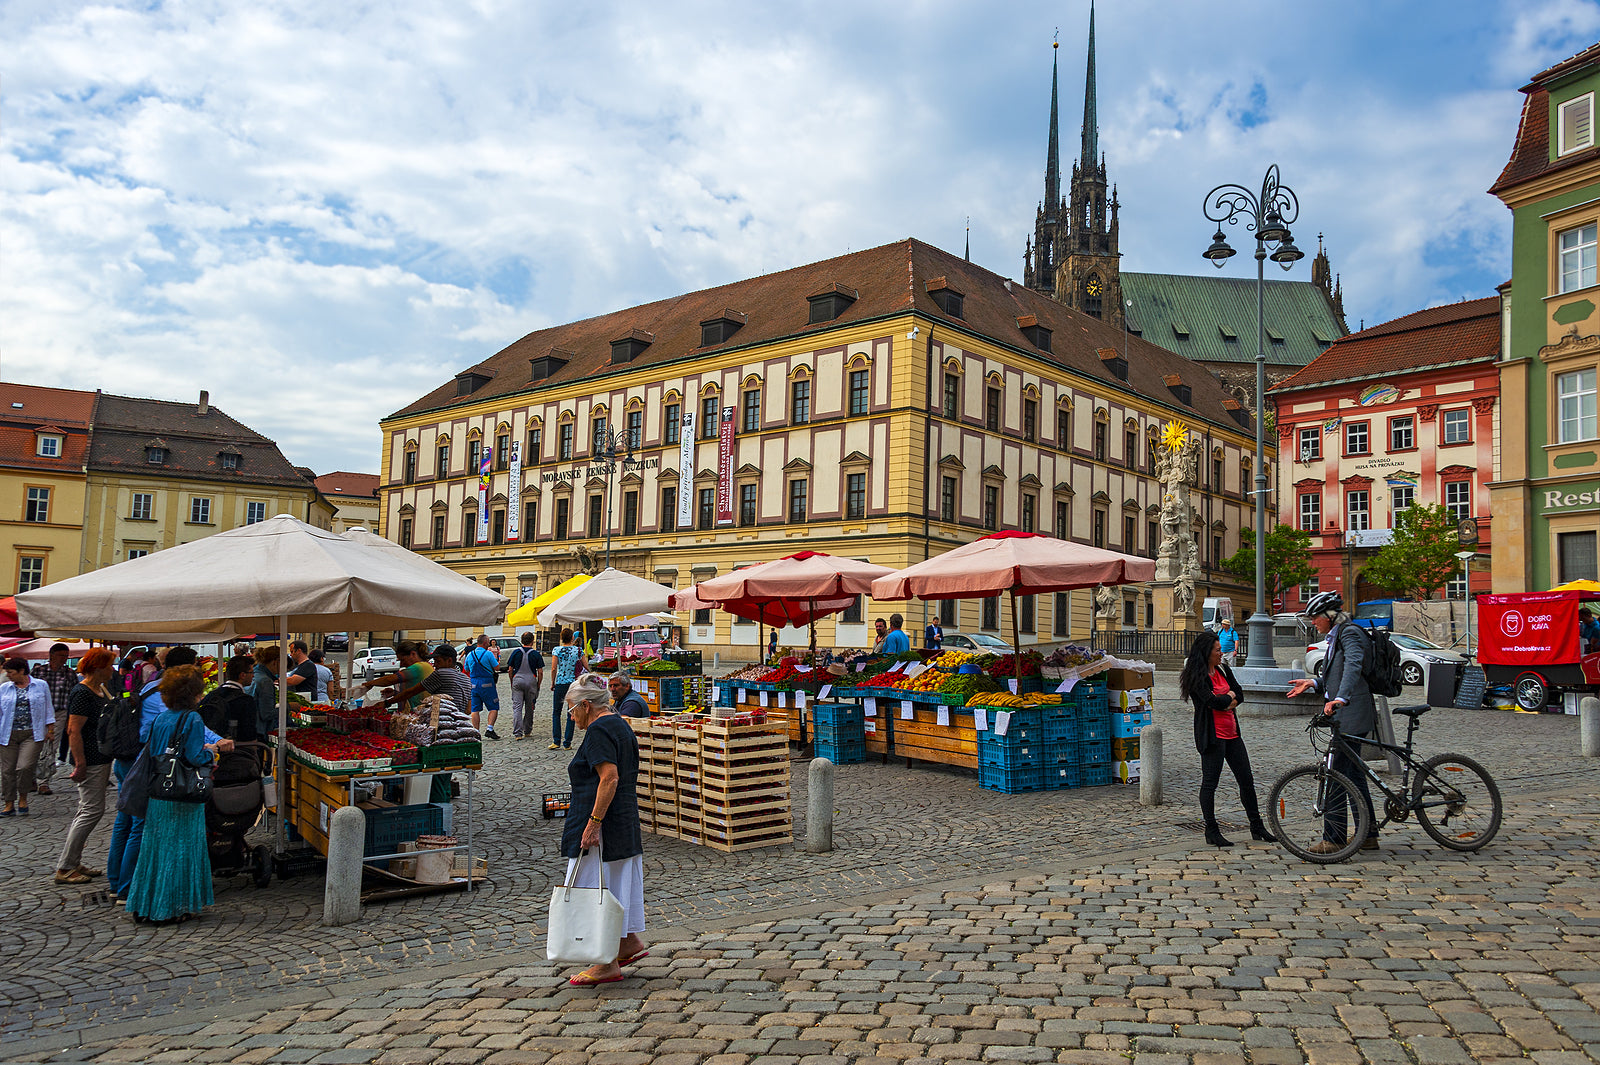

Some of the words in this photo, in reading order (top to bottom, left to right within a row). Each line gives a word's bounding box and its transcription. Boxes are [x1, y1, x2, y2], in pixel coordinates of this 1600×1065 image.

[542, 467, 581, 483] MORAVSKÉ
[623, 458, 659, 472] MUZEUM
[1543, 488, 1600, 509] Rest
[1527, 614, 1552, 623] DOBRO
